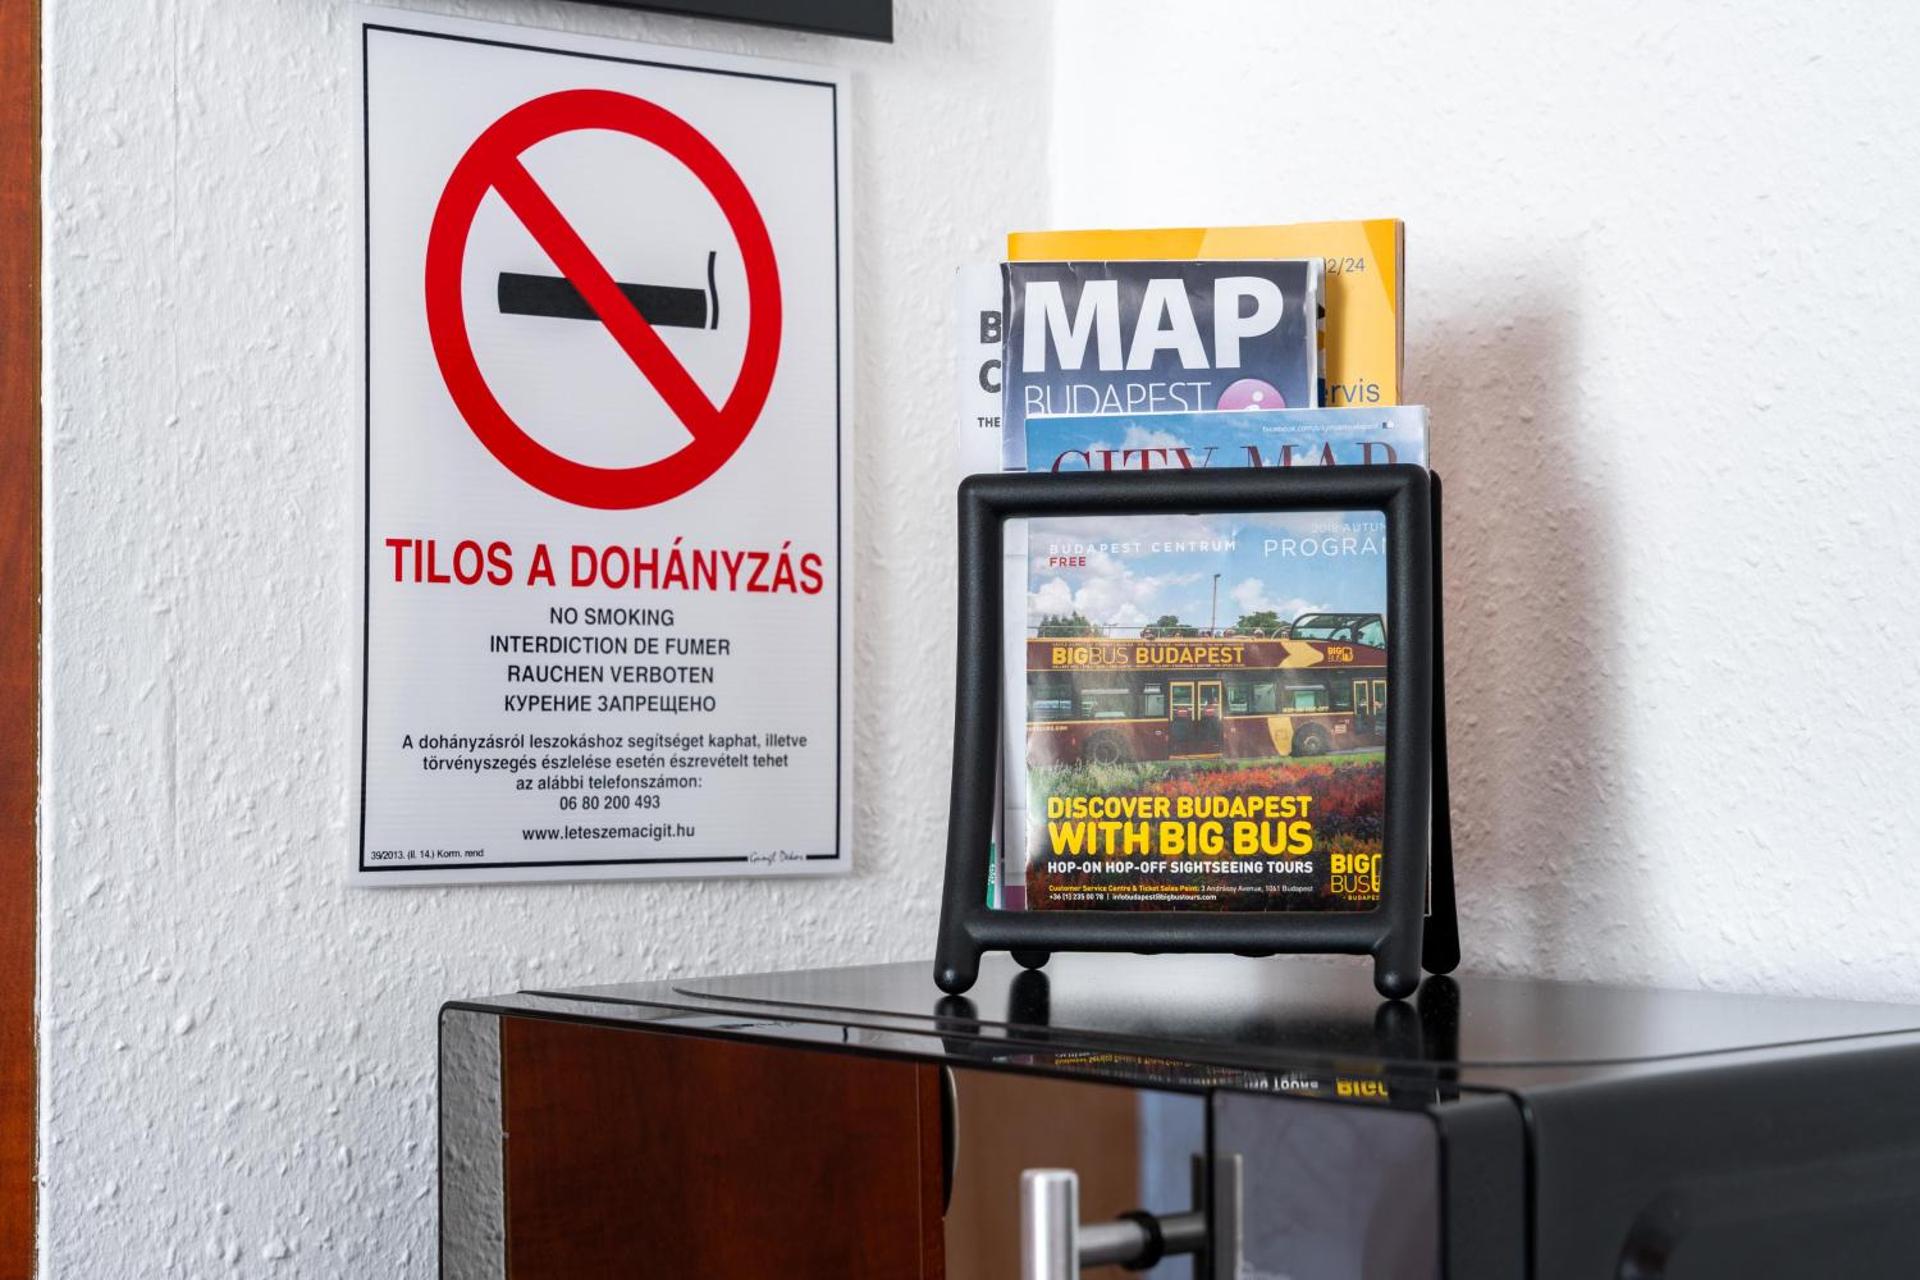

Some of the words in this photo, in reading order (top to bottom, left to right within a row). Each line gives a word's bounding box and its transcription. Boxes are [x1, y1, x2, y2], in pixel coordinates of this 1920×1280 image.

[1022, 276, 1284, 372] MAP
[1025, 382, 1211, 414] BUDAPEST
[1325, 378, 1380, 403] rvis
[978, 417, 1000, 427] THE
[1050, 543, 1141, 554] BUDAPEST
[1151, 541, 1236, 552] CENTRUM
[1264, 537, 1385, 557] PROGRA
[385, 538, 514, 587] TILOS
[526, 543, 557, 587] A
[571, 536, 824, 596] DOHÁNYZÁS
[1050, 557, 1086, 567] FREE
[550, 606, 578, 625] NO
[584, 607, 674, 627] SMOKING
[490, 634, 627, 655] INTERDICTION
[634, 637, 659, 655] DE
[665, 637, 730, 656] FUMER
[1136, 646, 1245, 664] BUDAPEST
[507, 664, 604, 683] RAUCHEN
[610, 665, 714, 684] VERBOTEN
[504, 694, 592, 712] КУРЕНИЕ
[597, 695, 716, 715] ЗАПРЕЩЕНО
[402, 734, 414, 750] A
[418, 733, 525, 753] dohányzásról
[529, 733, 623, 749] leszokáshoz
[627, 734, 704, 752] segítséget
[708, 733, 761, 751] kaphat,
[765, 733, 807, 748] illetve
[422, 753, 538, 774] törvényszegés
[541, 754, 612, 770] észlelése
[615, 754, 665, 769] esetén
[668, 751, 749, 769] észrevételt
[752, 753, 788, 768] tehet
[516, 778, 533, 791] az
[537, 775, 584, 790] alábbi
[587, 773, 703, 790] telefonszámon:
[559, 796, 578, 811] 06
[581, 795, 600, 810] 80
[603, 795, 631, 810] 200
[634, 794, 661, 809] 493
[1048, 796, 1170, 819] DISCOVER
[1177, 795, 1313, 818] BUDAPEST
[522, 823, 695, 842] www.leteszemacigit.hu
[1048, 821, 1150, 855] WITH
[1159, 821, 1225, 856] BIG
[1233, 821, 1313, 855] BUS
[1047, 861, 1101, 874] HOP-ON
[1105, 861, 1167, 874] HOP-OFF
[1170, 861, 1263, 874] SIGHTSEEING
[1267, 861, 1313, 874] TOURS
[1331, 853, 1370, 874] BIG
[1331, 875, 1370, 893] BUS
